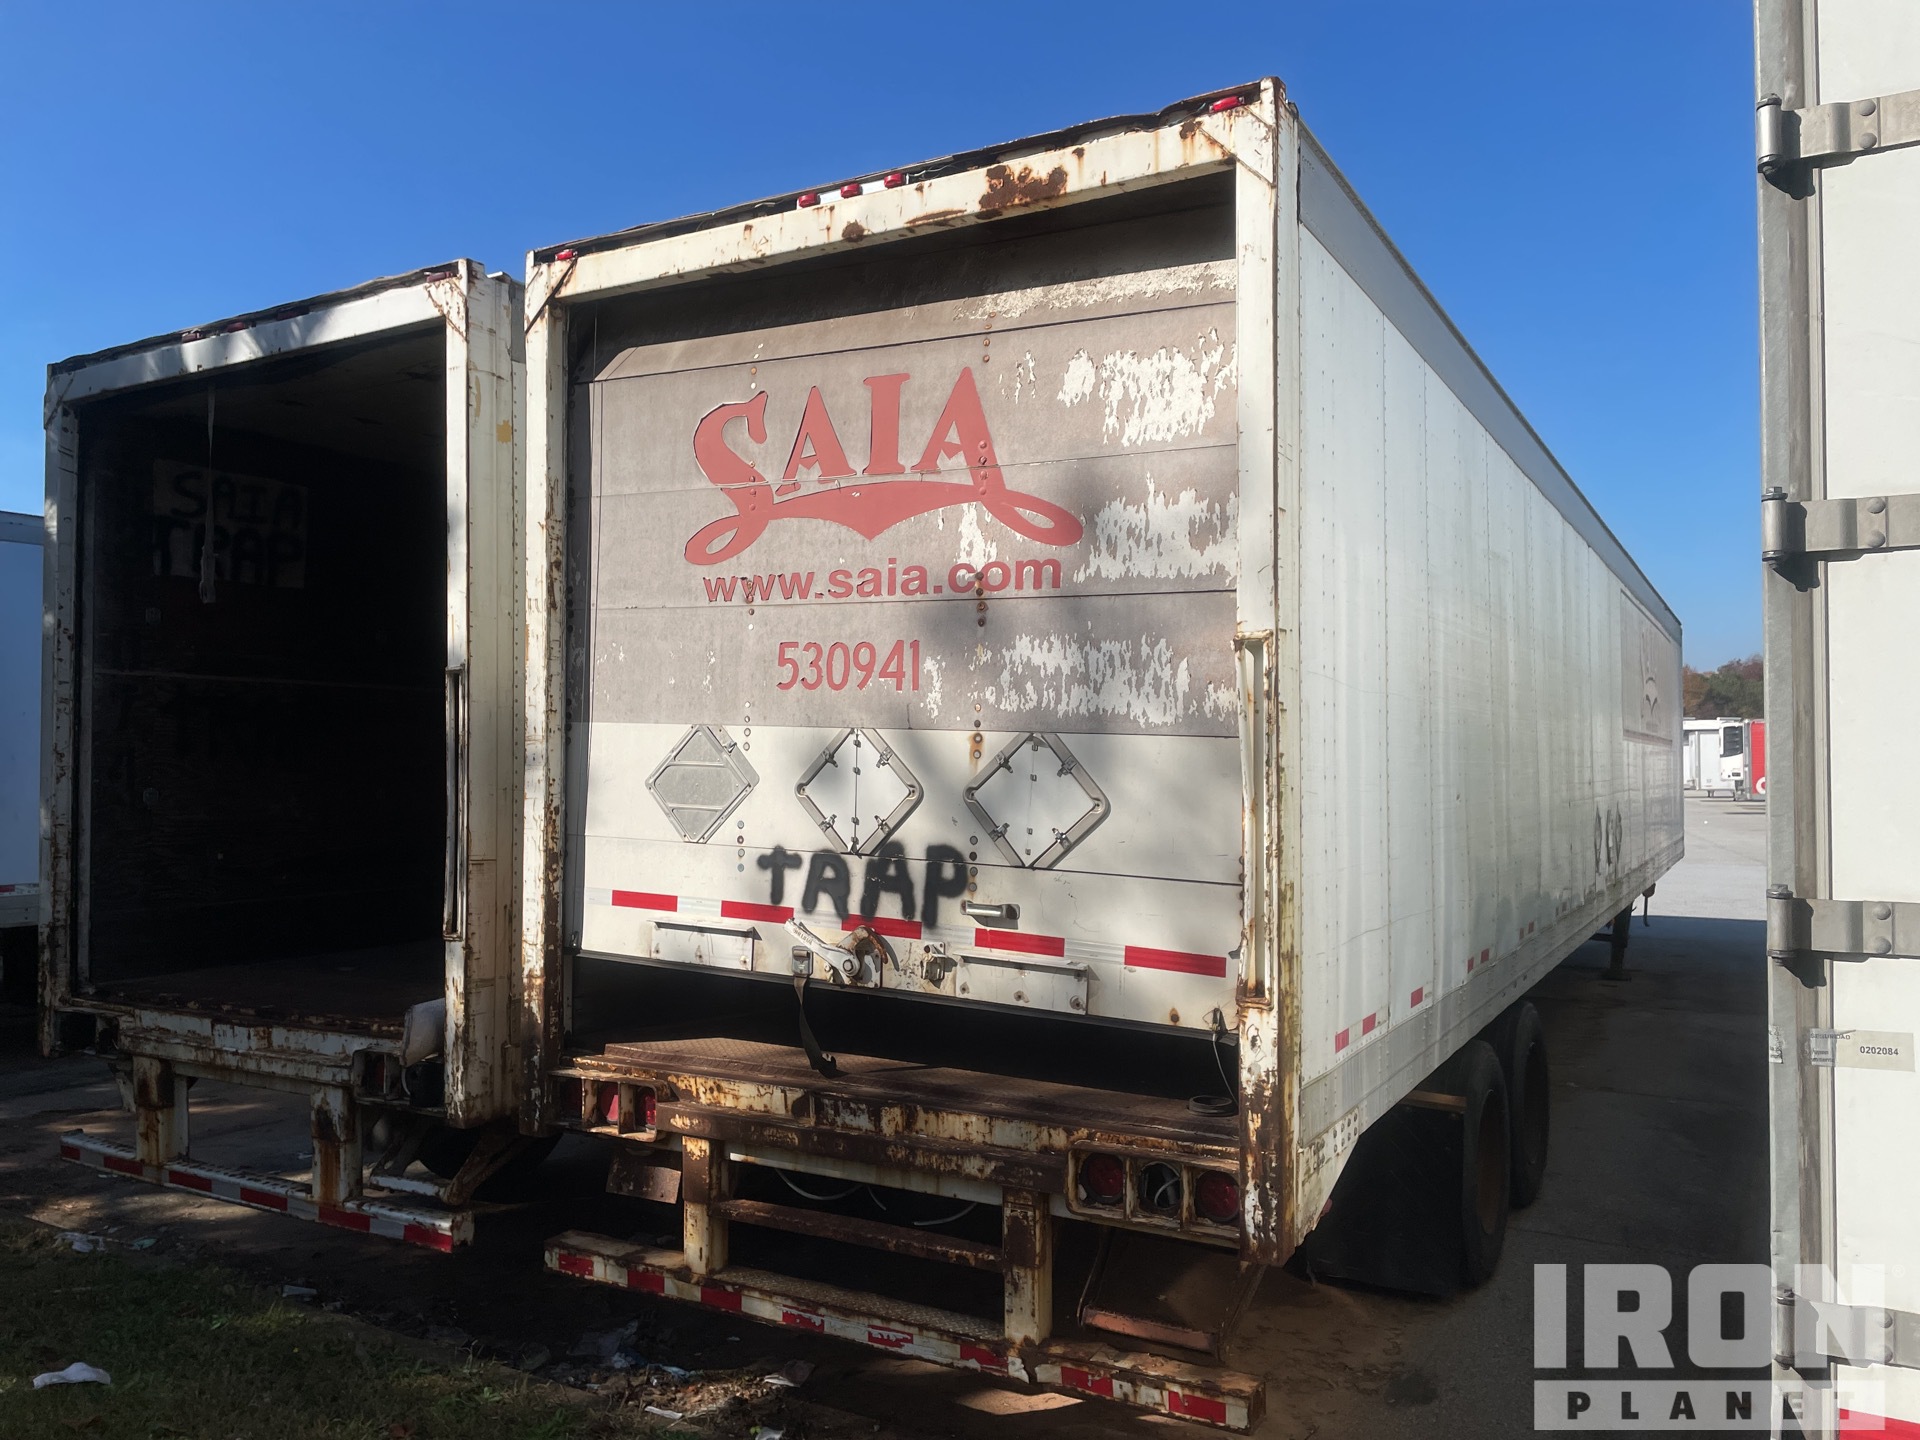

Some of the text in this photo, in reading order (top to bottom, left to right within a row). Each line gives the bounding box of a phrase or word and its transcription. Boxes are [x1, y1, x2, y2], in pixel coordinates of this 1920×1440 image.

[684, 366, 1015, 565] SAIA
[702, 556, 1062, 603] www.saia.com
[776, 638, 920, 692] 530941
[1859, 1045, 1899, 1056] 0202084
